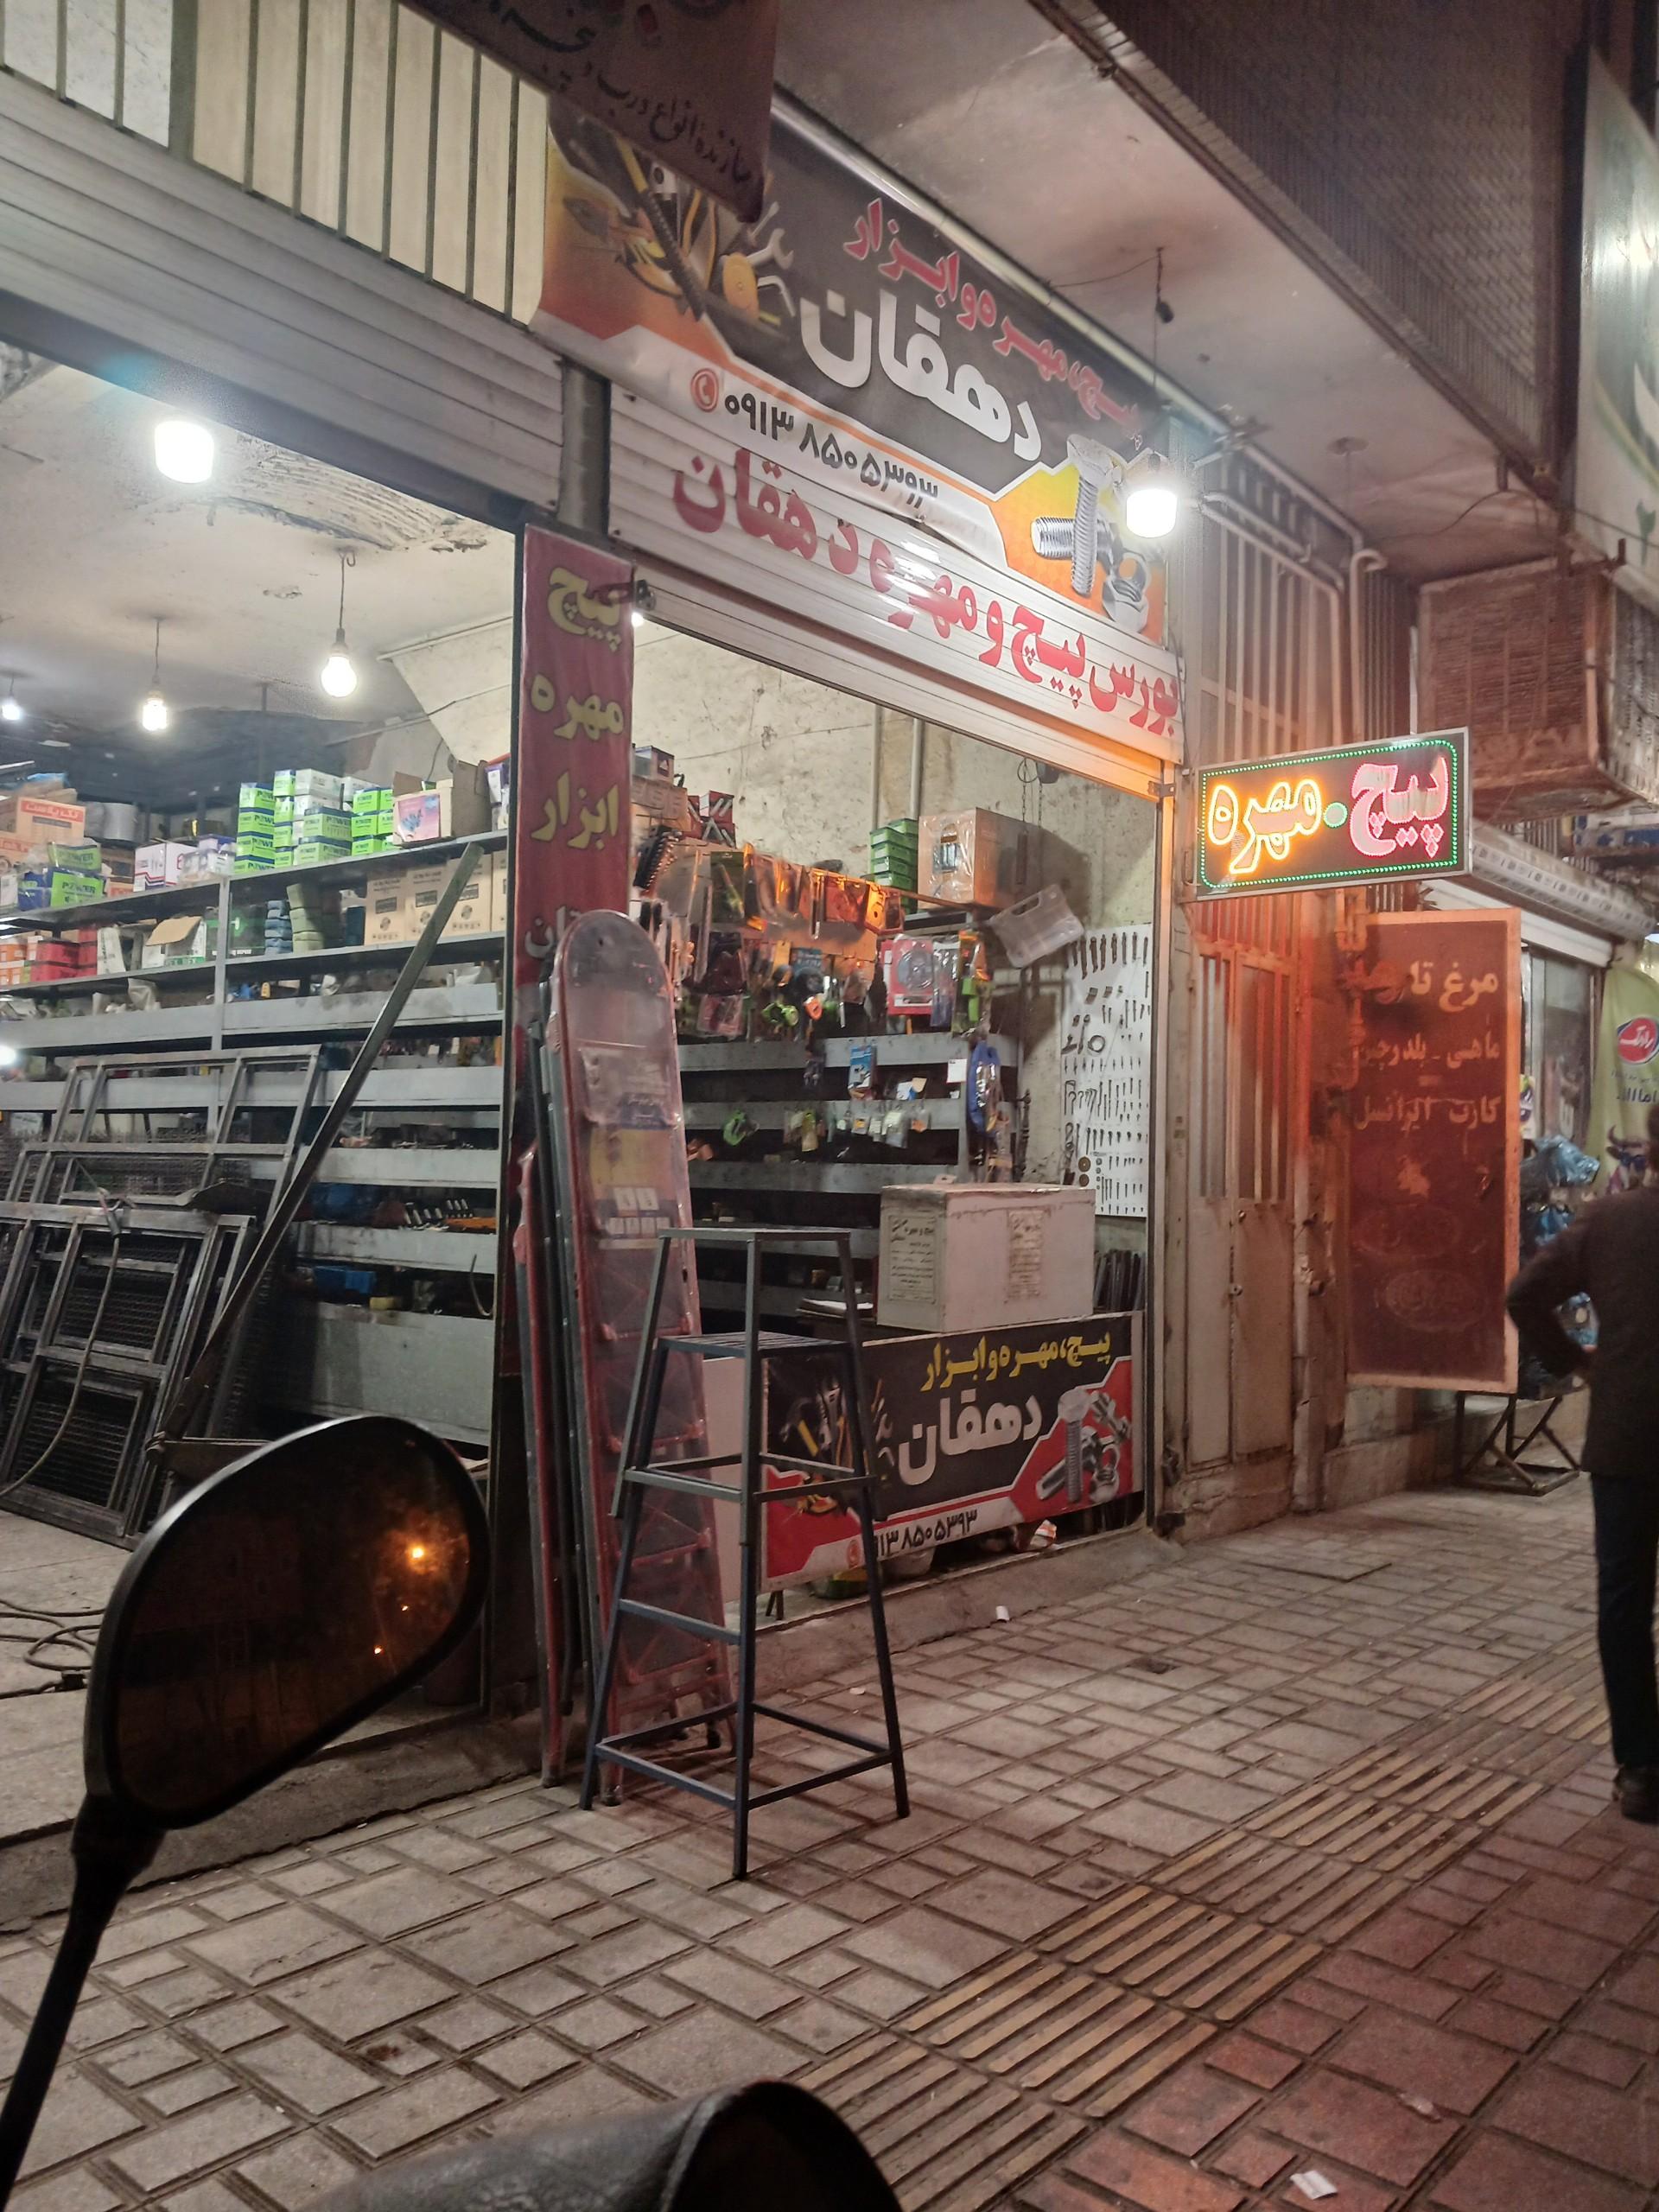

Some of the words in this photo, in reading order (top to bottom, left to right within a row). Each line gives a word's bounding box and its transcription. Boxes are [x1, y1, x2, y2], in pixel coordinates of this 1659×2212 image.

[842, 196, 961, 308] ابزار
[799, 290, 1042, 461] دهقان
[672, 447, 860, 575] دهقان
[547, 565, 623, 652] پیچ
[868, 537, 978, 639] مهره
[978, 600, 1005, 668] و
[1011, 605, 1086, 709] پیچ
[530, 671, 625, 741] مهره
[1089, 661, 1179, 737] بورس
[530, 769, 619, 850] ابزار
[1207, 778, 1323, 875] مهره
[1349, 755, 1449, 859] پیچ
[1438, 961, 1499, 1013] مرغ
[1446, 1030, 1501, 1069] ماهی
[1448, 1094, 1502, 1130] کارت
[919, 1335, 987, 1392] ابزار
[898, 1388, 1044, 1486] دهقان
